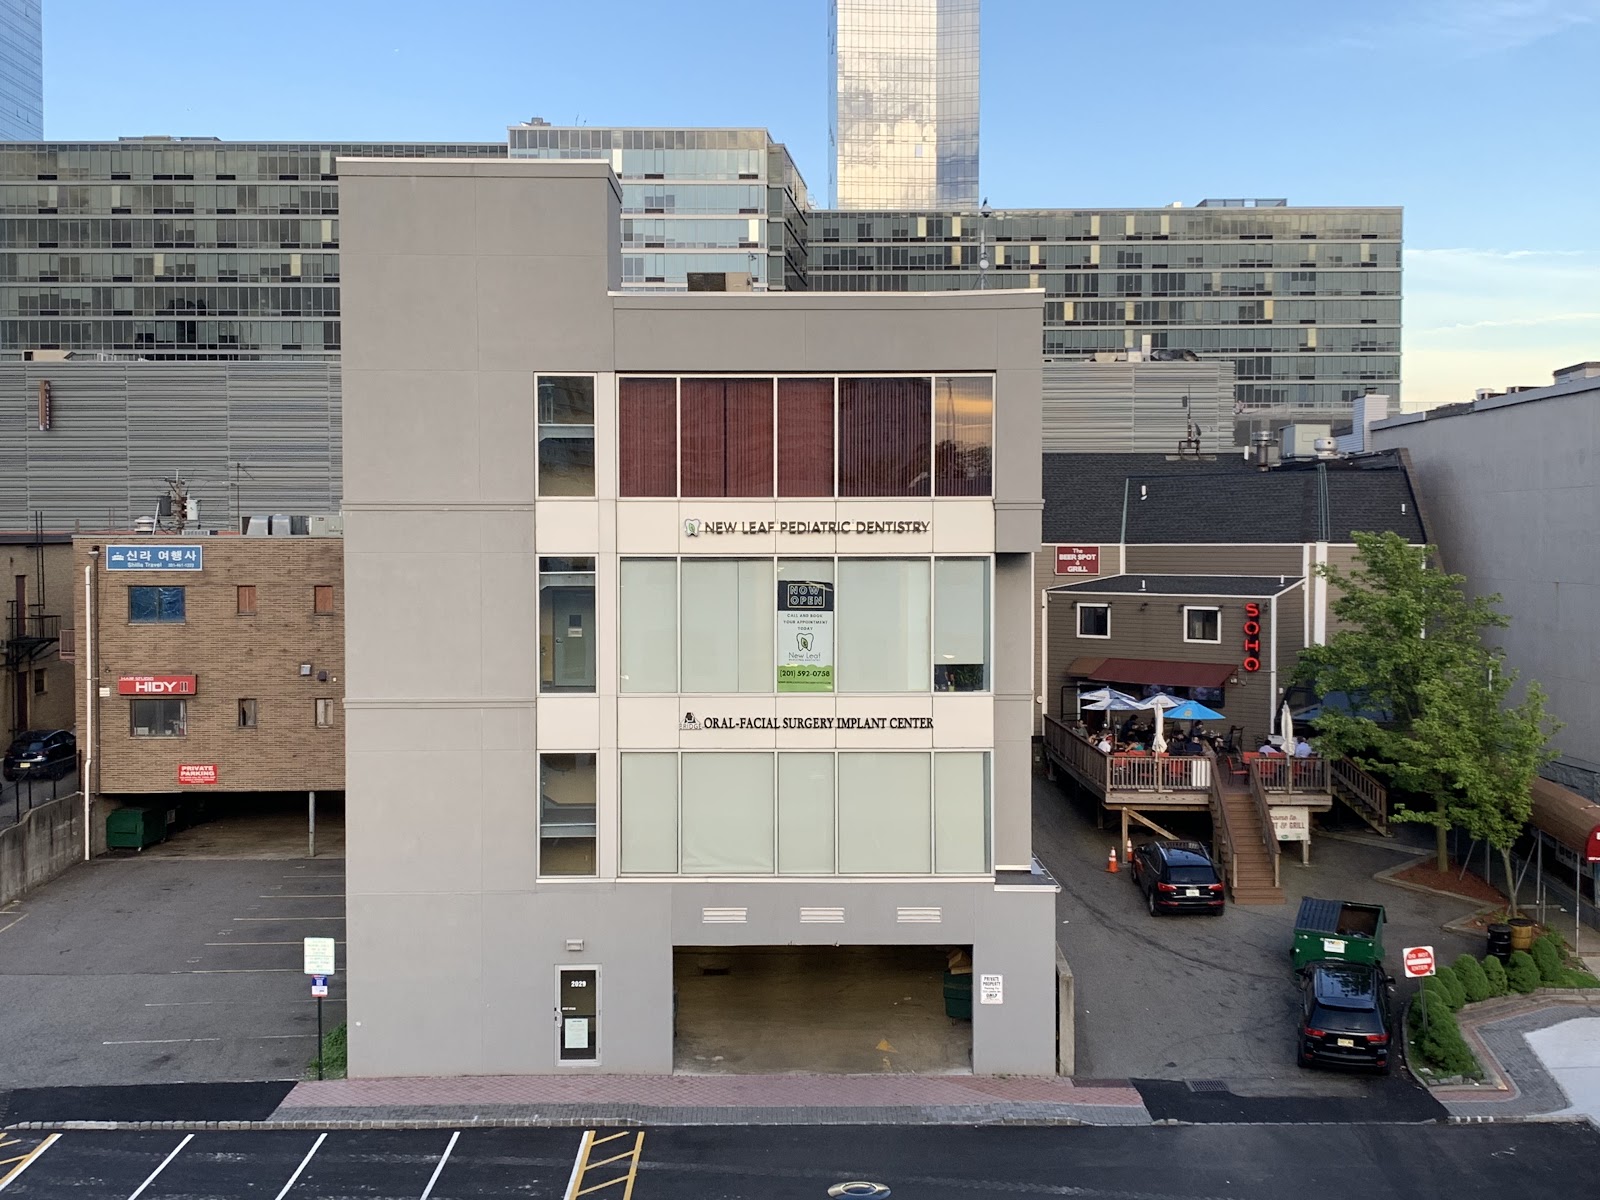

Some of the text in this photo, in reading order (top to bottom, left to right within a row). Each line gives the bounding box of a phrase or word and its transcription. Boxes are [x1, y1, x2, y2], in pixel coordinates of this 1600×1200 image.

[704, 521, 930, 534] NEW LEAF PEDIATRIC DENTISTRY
[126, 550, 196, 561] 신라 여행사
[790, 586, 819, 595] NOW
[790, 596, 822, 605] OPEN
[1244, 603, 1259, 670] SOHO
[780, 670, 795, 678] (201)
[136, 682, 177, 692] HIDY
[704, 717, 780, 729] ORAL-FACIAL
[783, 717, 834, 729] SURGERY
[837, 718, 887, 729] IMPLANT
[890, 717, 934, 729] CENTER
